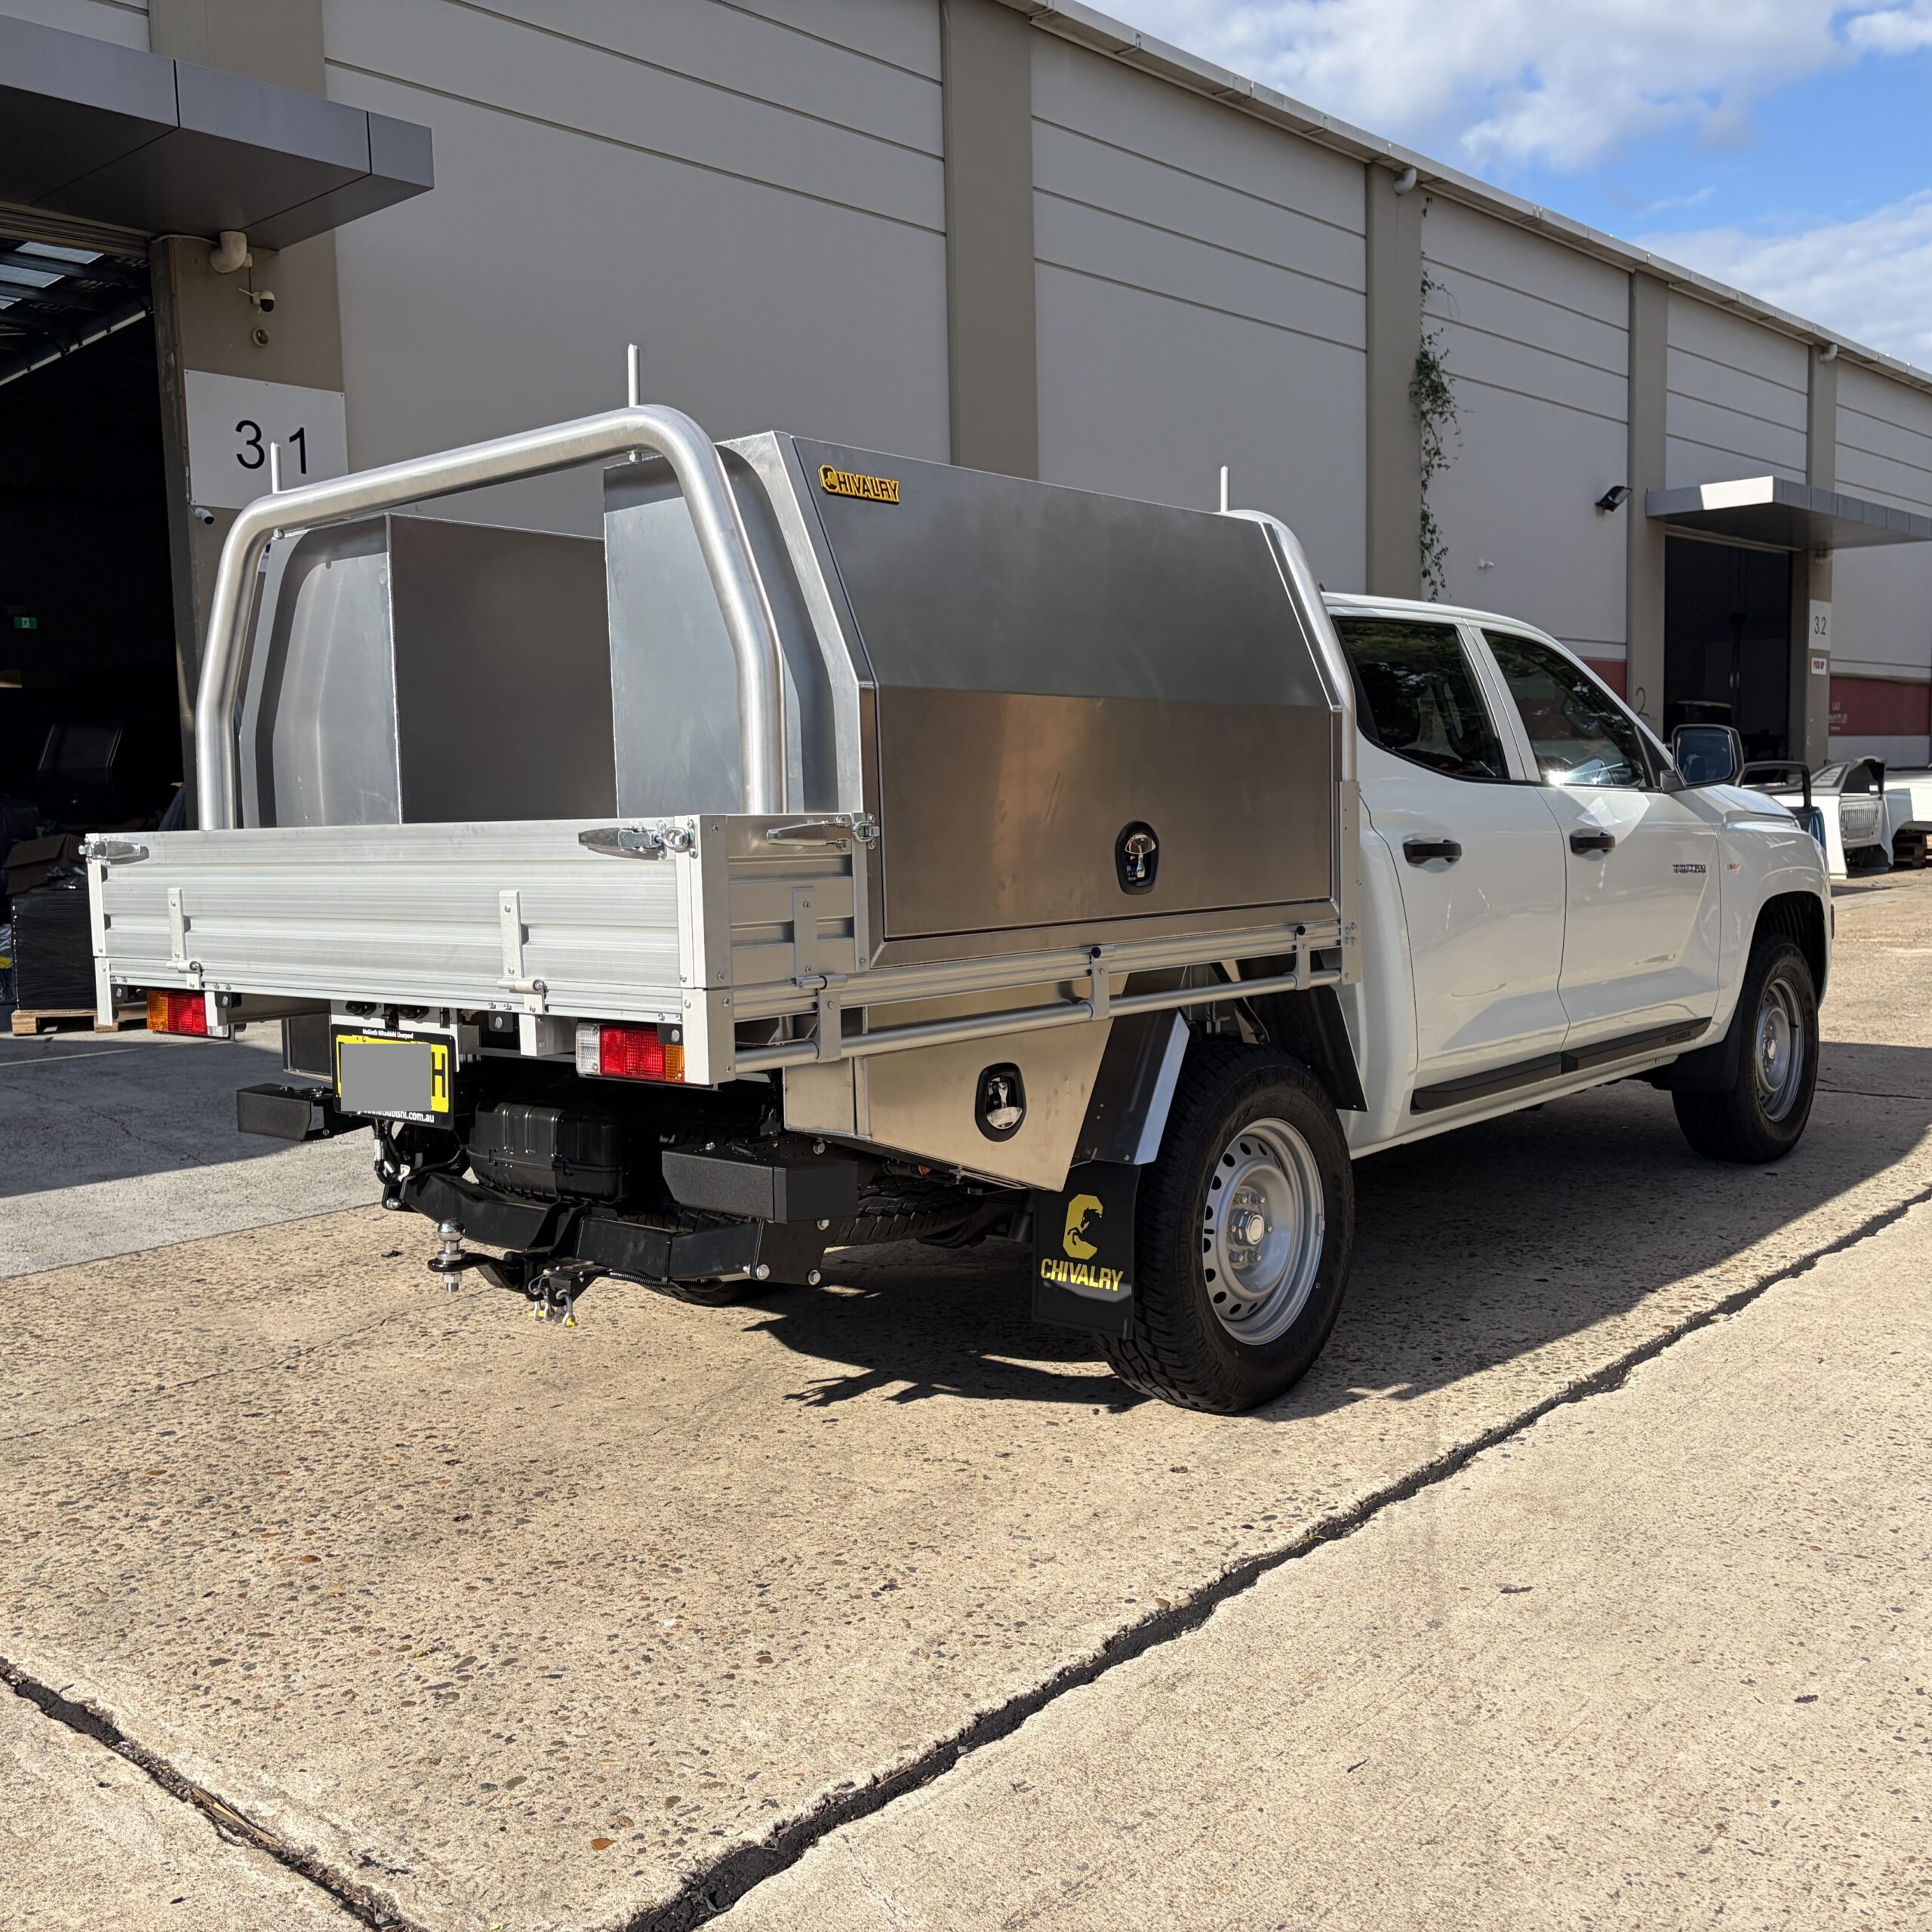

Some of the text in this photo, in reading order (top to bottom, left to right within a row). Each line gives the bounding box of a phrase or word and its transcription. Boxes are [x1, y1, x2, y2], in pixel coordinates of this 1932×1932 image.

[818, 464, 900, 504] CHIVALRY
[1814, 615, 1826, 635] 3.2
[1040, 1257, 1124, 1291] CHIVALRY
